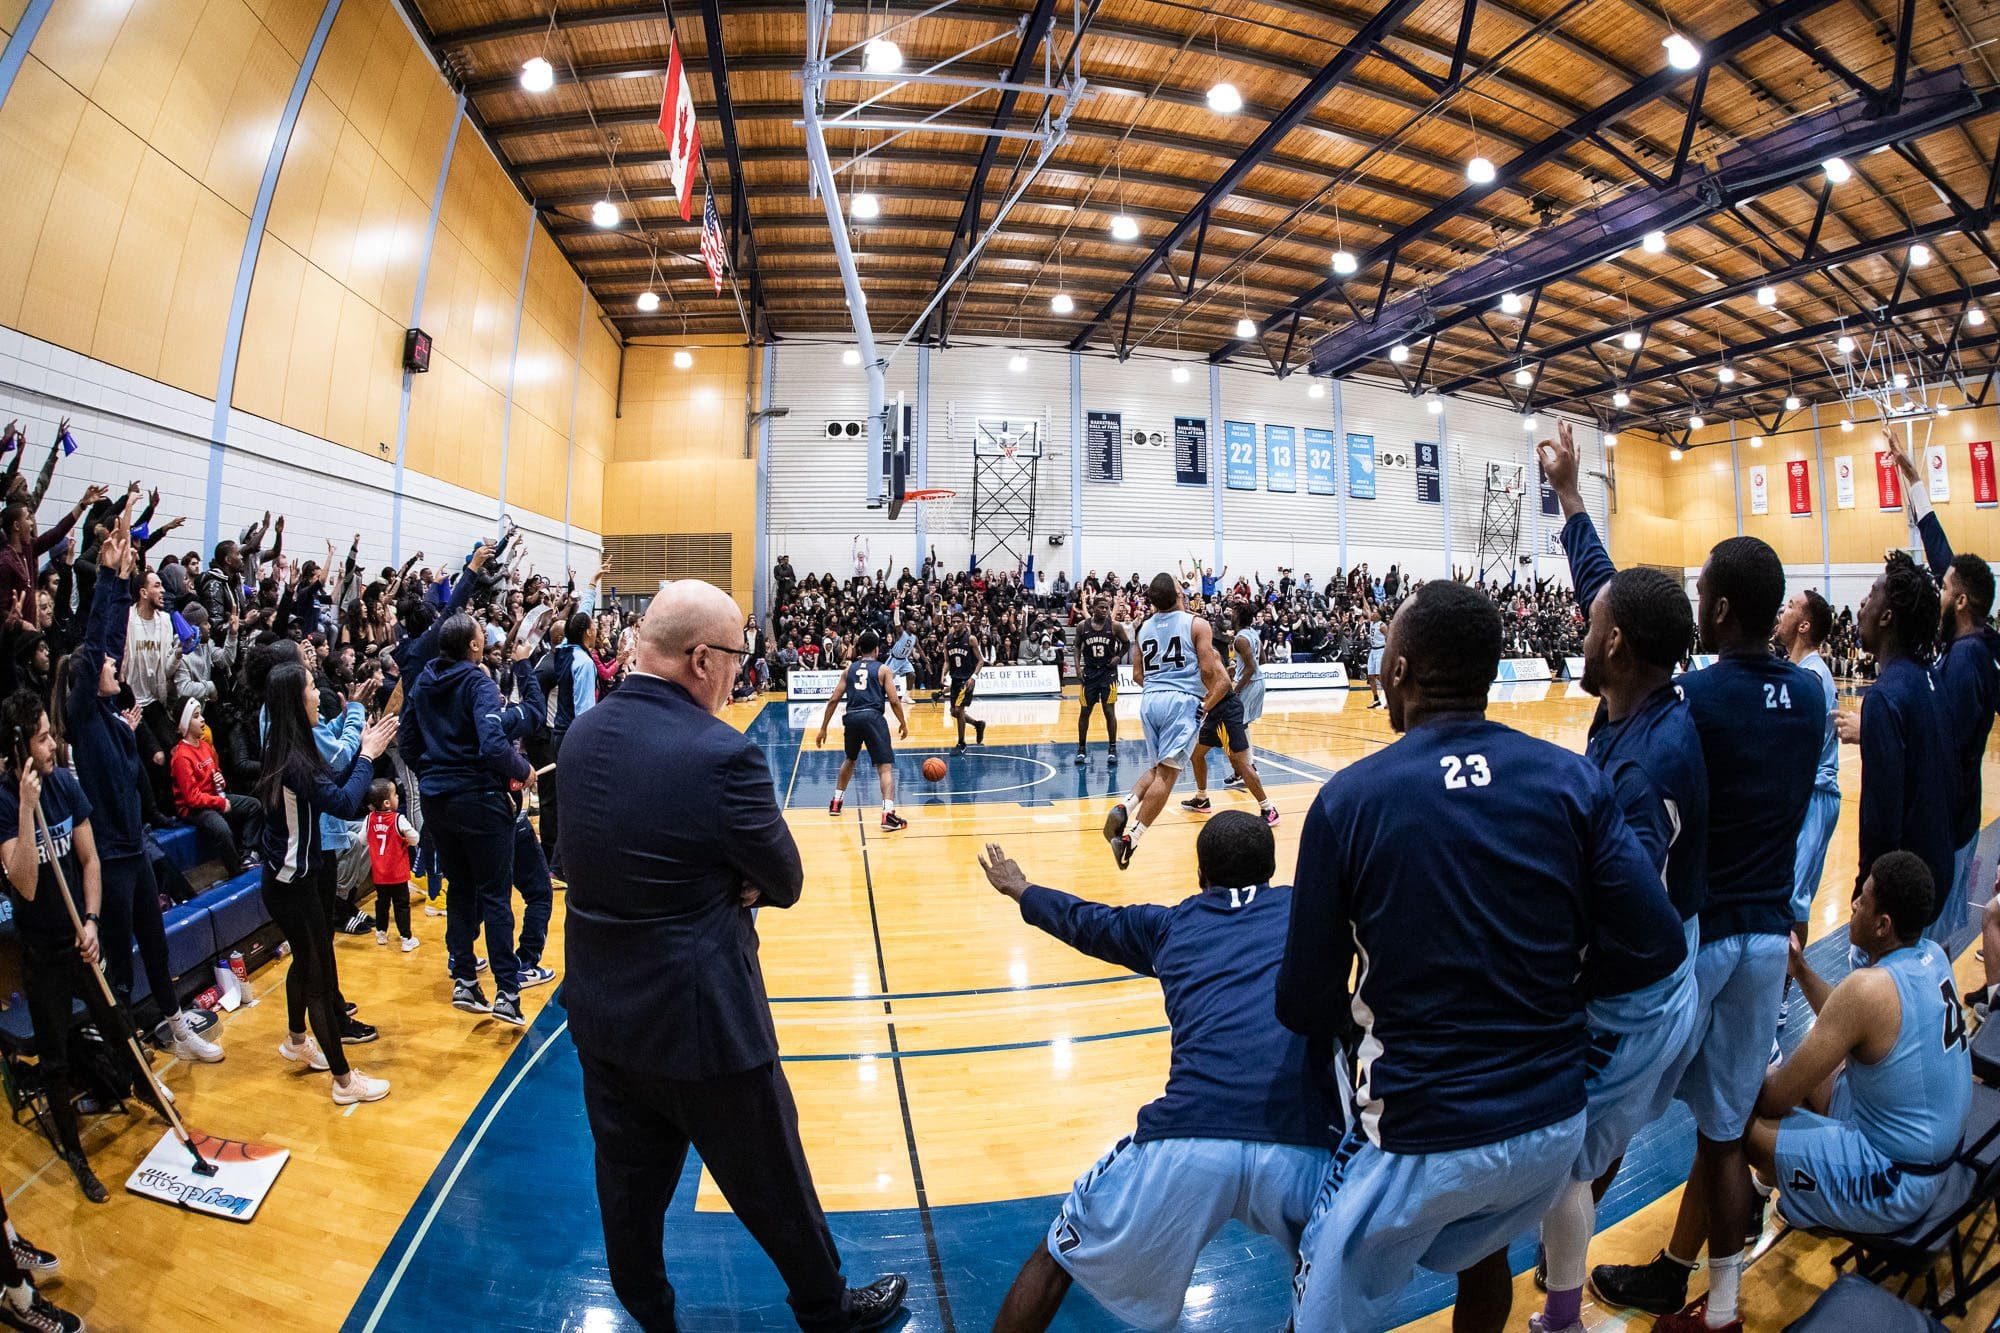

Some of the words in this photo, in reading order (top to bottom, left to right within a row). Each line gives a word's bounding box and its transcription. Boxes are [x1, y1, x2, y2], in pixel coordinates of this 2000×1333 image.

[1230, 442, 1253, 465] 22
[1271, 446, 1291, 467] 13
[1310, 449, 1331, 470] 32
[1421, 445, 1432, 462] S
[906, 639, 912, 648] S
[1086, 636, 1110, 646] HUMBER
[1092, 645, 1105, 657] 13
[1142, 635, 1187, 672] 24
[854, 668, 869, 690] 3
[999, 670, 1011, 679] OF
[1015, 669, 1038, 679] THE
[1763, 683, 1792, 709] 24
[1440, 754, 1491, 790] 23
[376, 834, 387, 856] 7
[1229, 885, 1257, 908] 17
[1939, 976, 1968, 1054] 4
[1789, 1168, 1818, 1193] 4
[139, 1172, 254, 1216] keyclean
